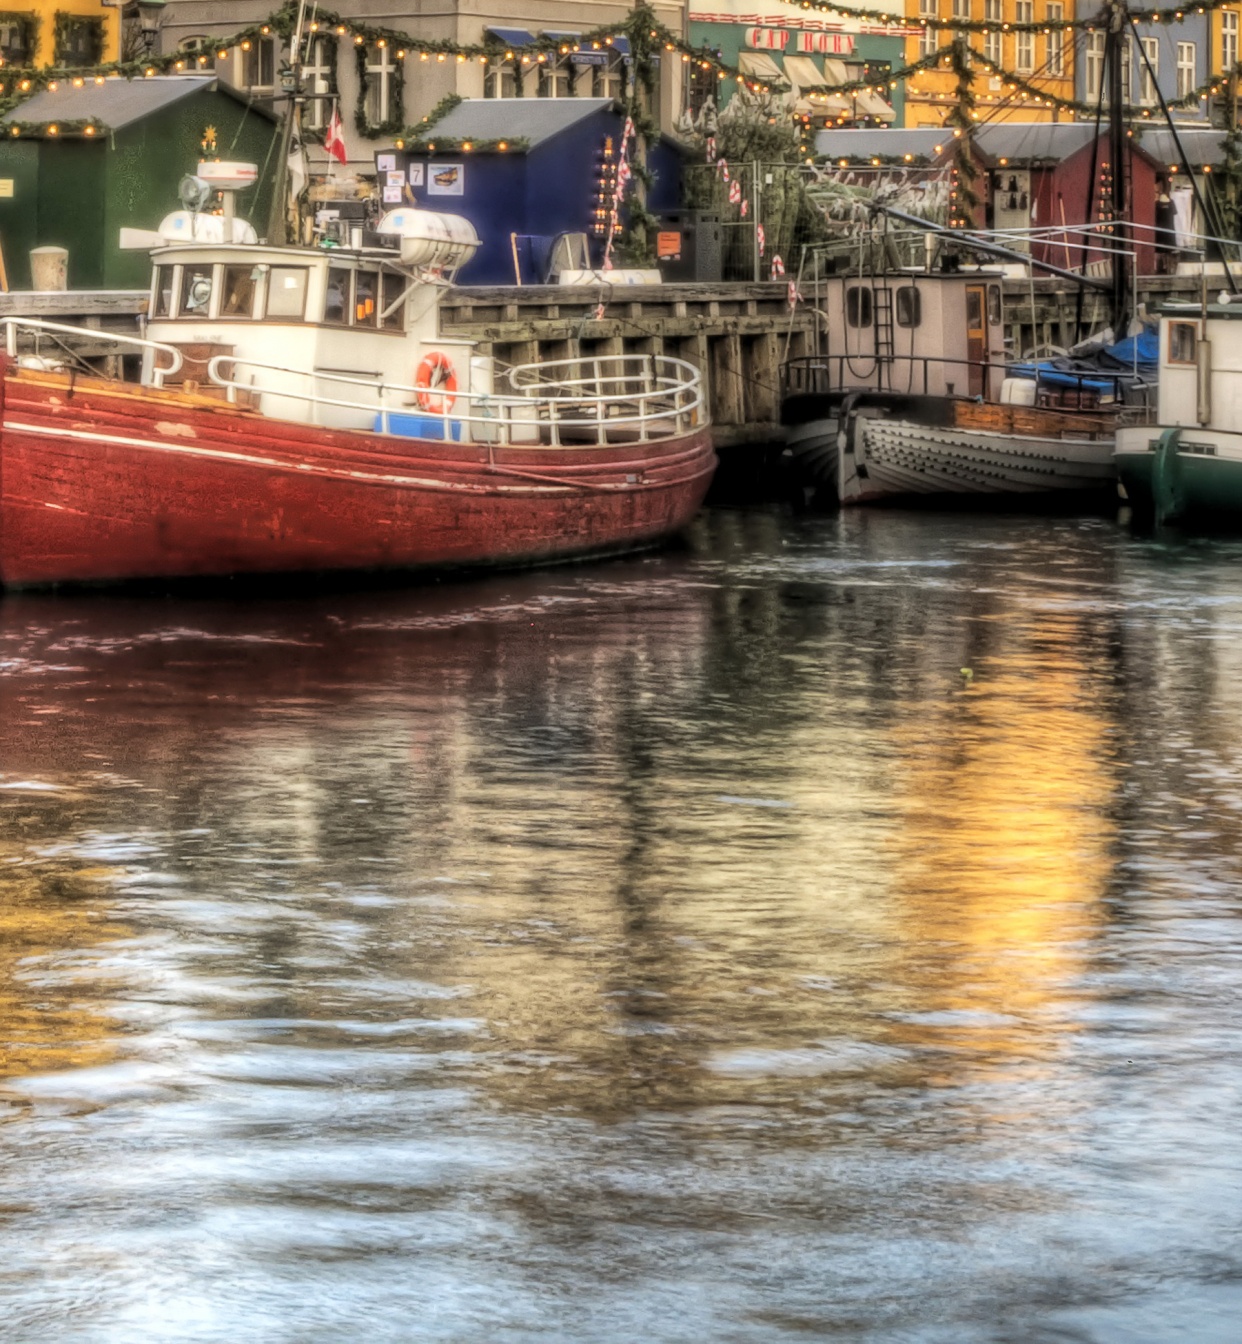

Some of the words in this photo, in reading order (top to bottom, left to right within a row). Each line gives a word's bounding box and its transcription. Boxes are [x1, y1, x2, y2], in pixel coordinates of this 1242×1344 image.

[746, 27, 789, 51] CAP
[798, 31, 855, 55] HORN
[413, 169, 420, 182] 7
